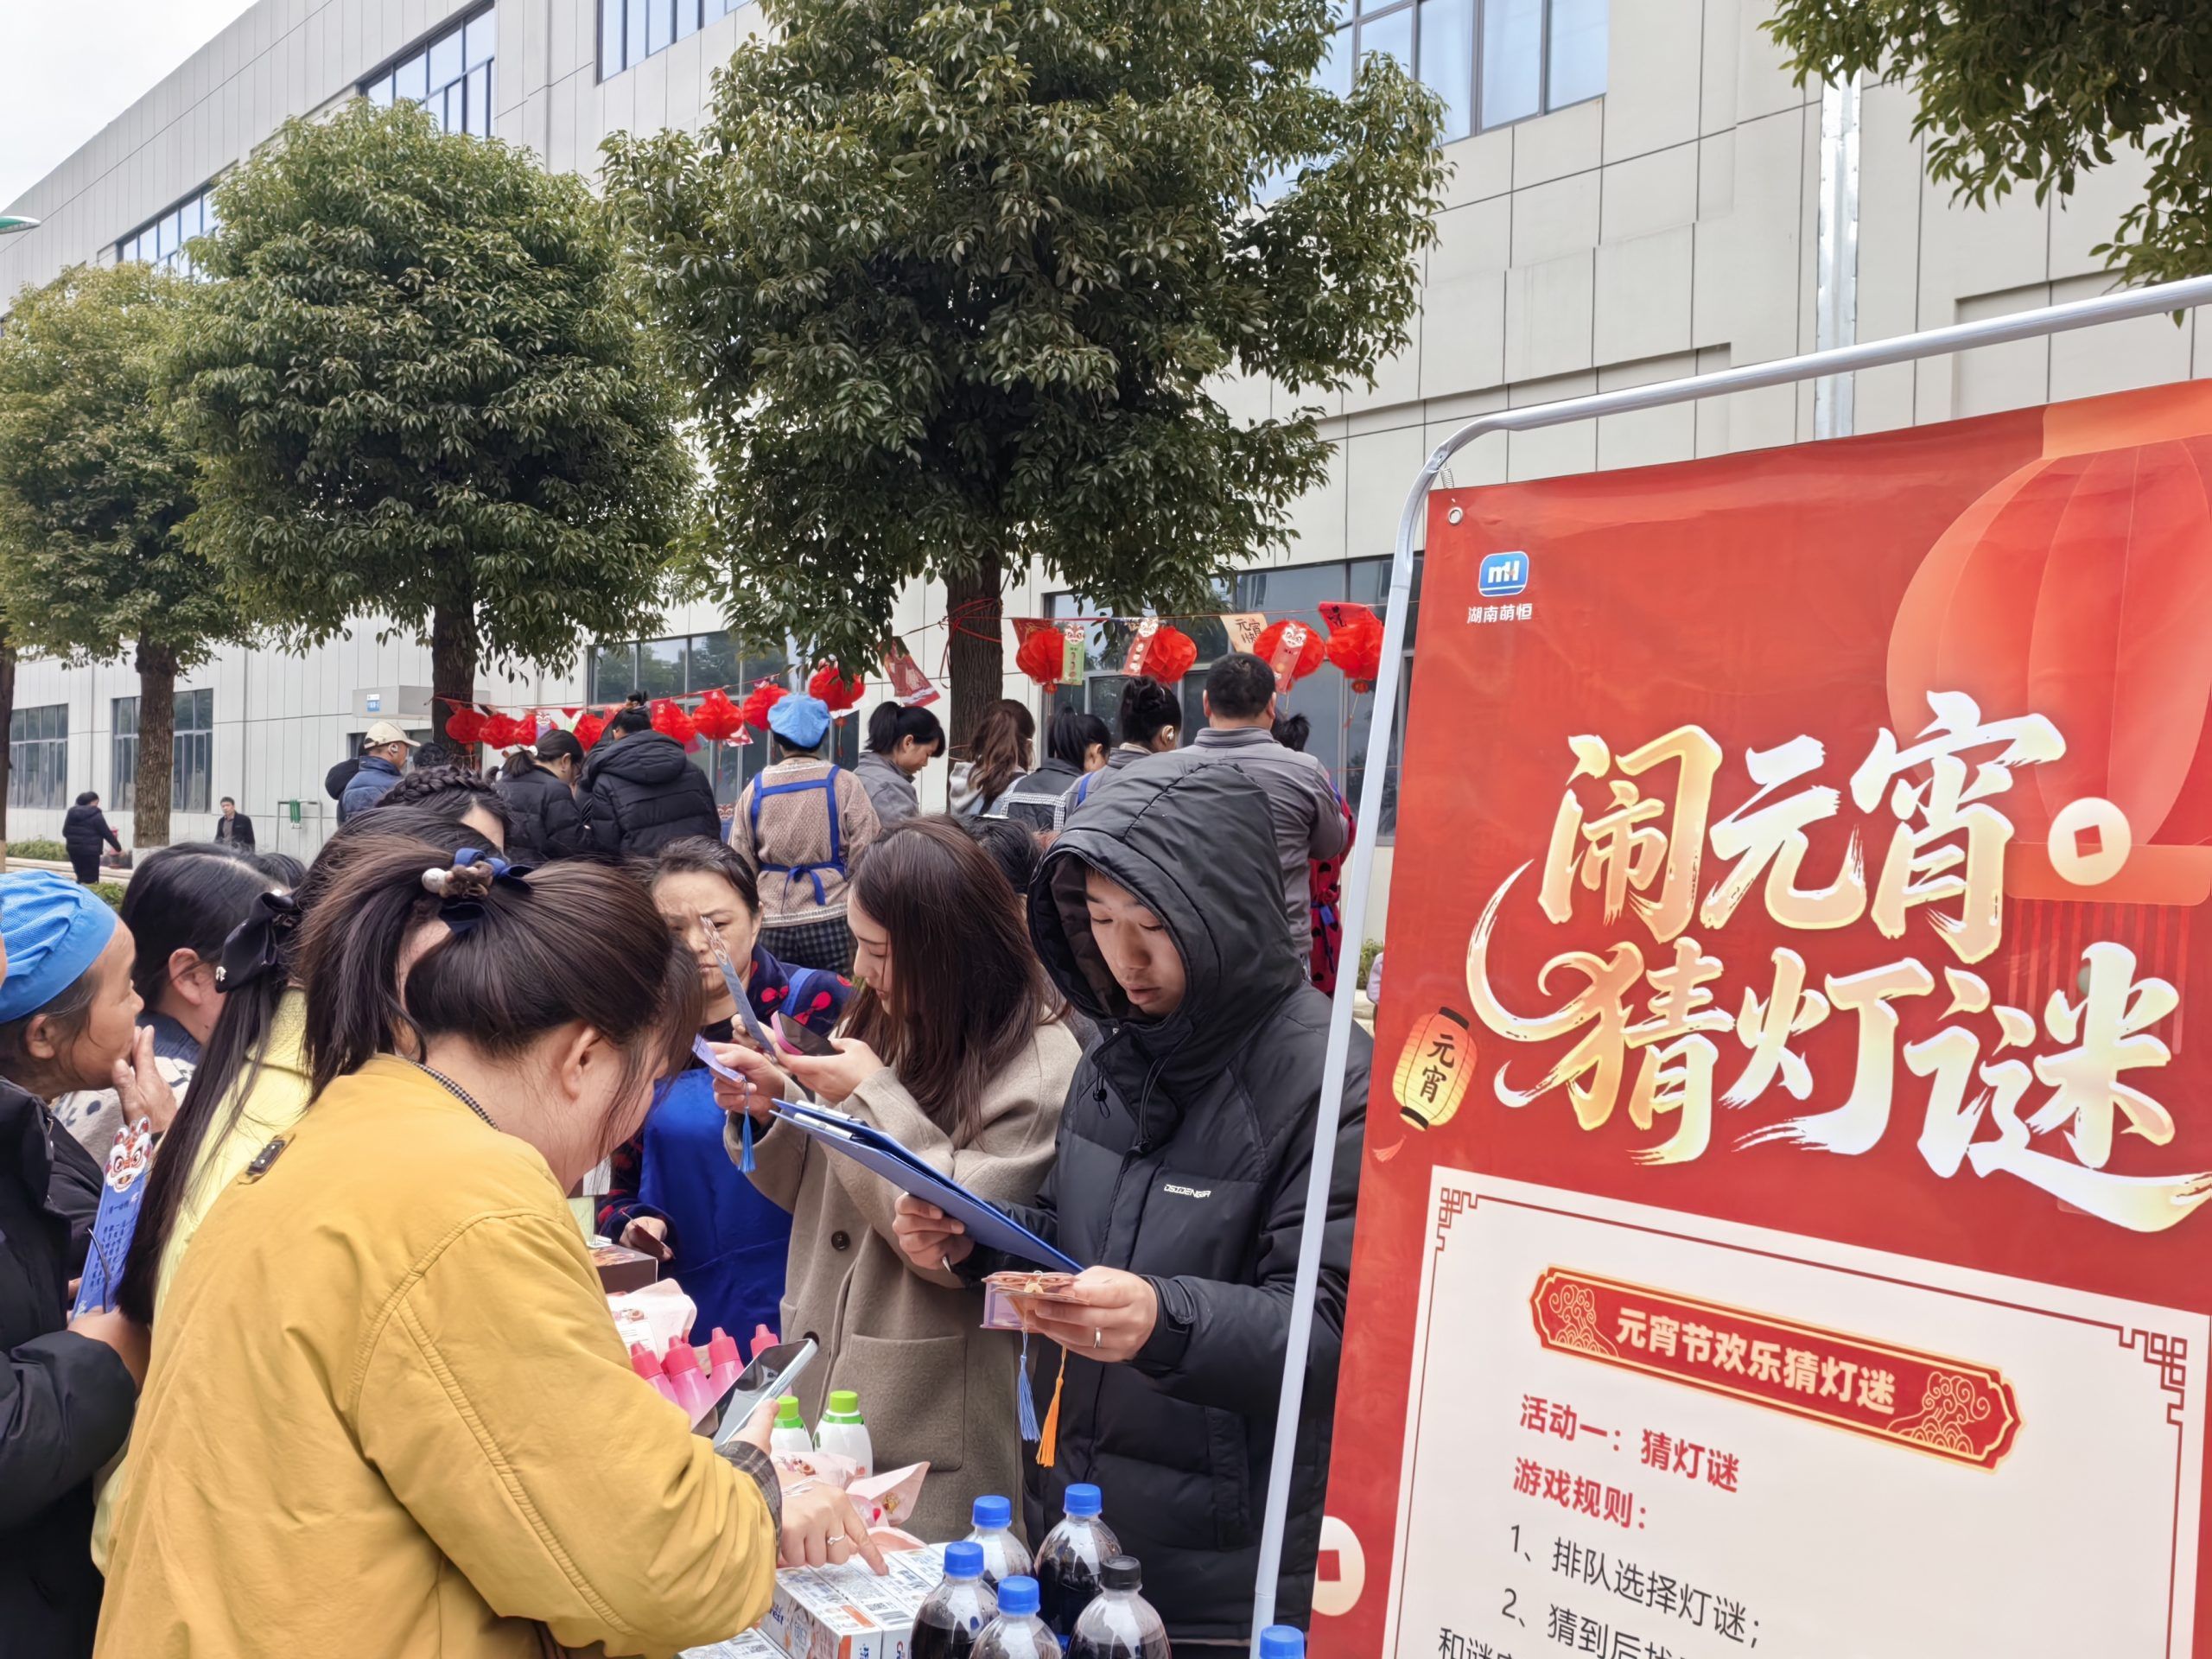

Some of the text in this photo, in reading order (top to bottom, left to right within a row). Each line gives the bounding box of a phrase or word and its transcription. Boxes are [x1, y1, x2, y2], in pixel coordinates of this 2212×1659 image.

[1466, 603, 1533, 624] 湖南萌恒
[1539, 690, 2067, 964] 闹元宵
[1420, 1033, 1456, 1103] 元宵
[1467, 938, 2212, 1232] 猜灯谜
[1519, 1394, 1740, 1493] 活动一：猜灯谜
[1513, 1457, 1647, 1529] 游戏规则：
